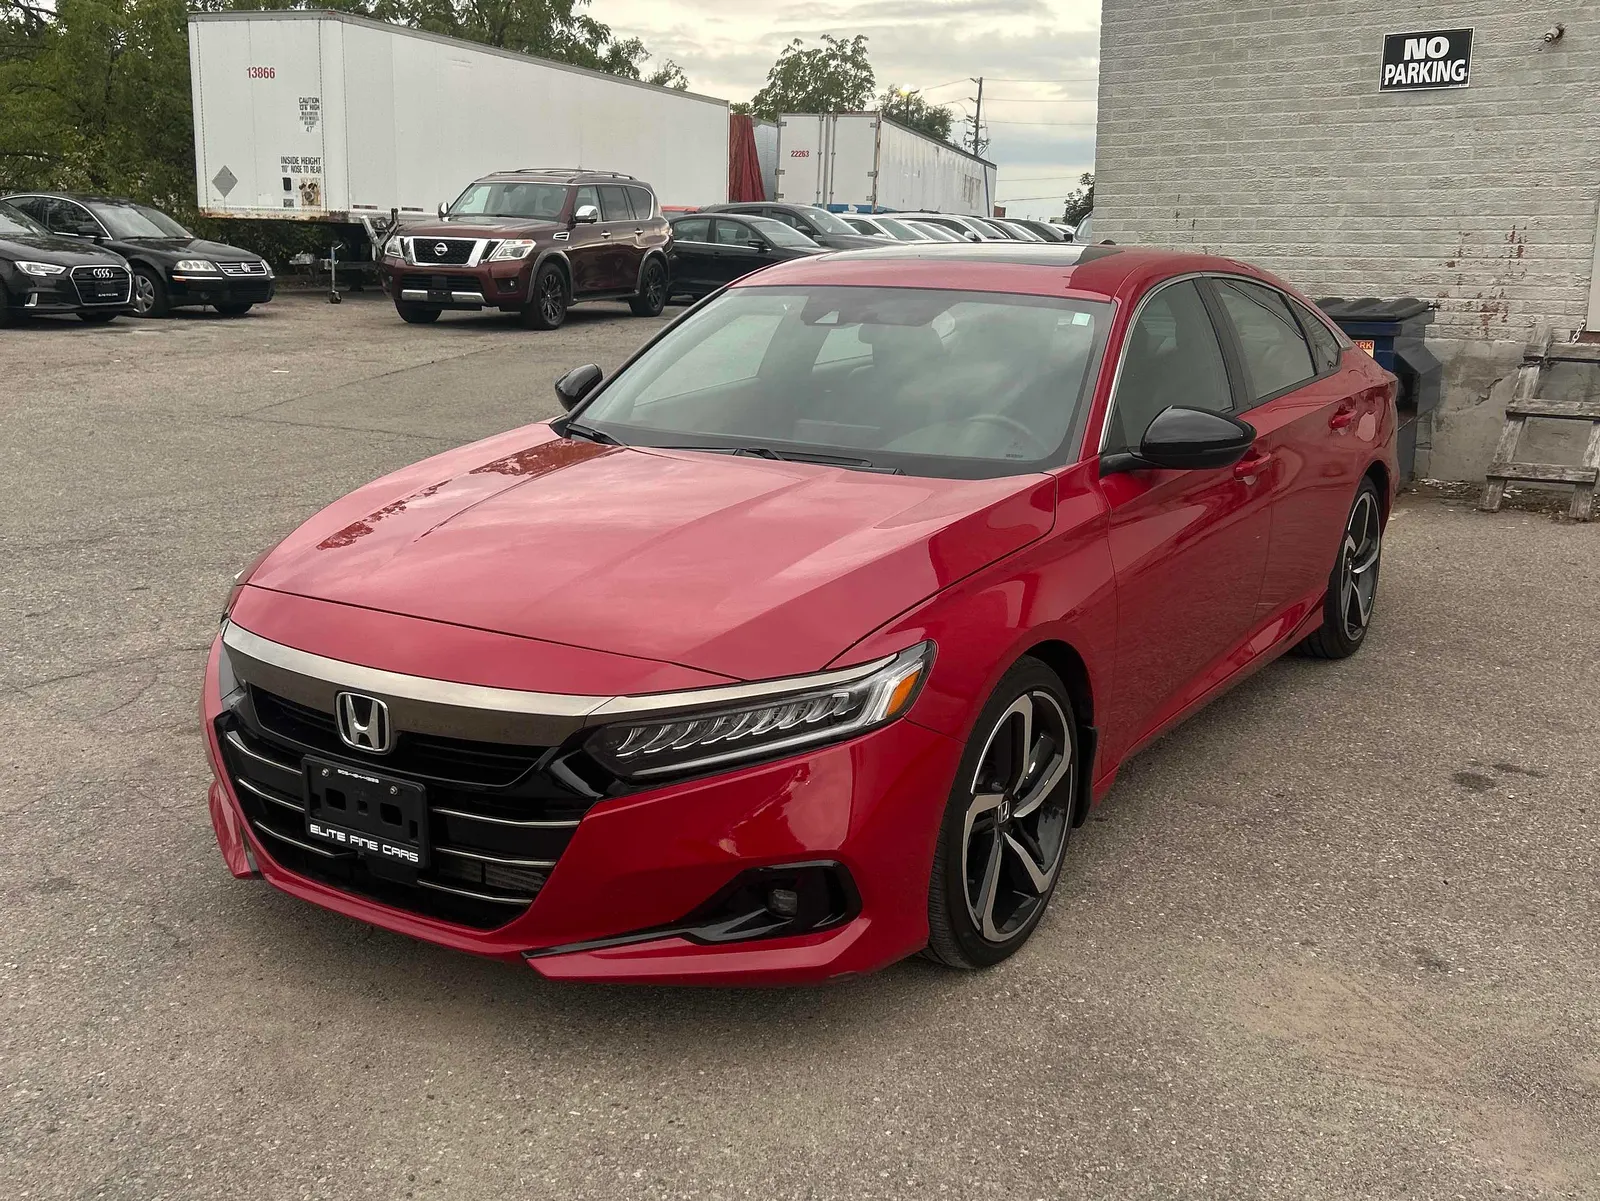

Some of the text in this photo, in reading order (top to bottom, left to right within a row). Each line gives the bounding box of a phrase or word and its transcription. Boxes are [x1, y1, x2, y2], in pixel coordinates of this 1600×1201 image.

[1404, 36, 1450, 61] NO
[246, 66, 276, 79] 13866
[1383, 59, 1466, 86] PARKING
[299, 96, 320, 104] CAUTION
[281, 156, 321, 165] INSIDE HEIGHT
[290, 165, 302, 174] NOSE
[303, 165, 310, 174] TO
[310, 165, 321, 174] REAR
[309, 823, 419, 863] ELITE FINE CARS
